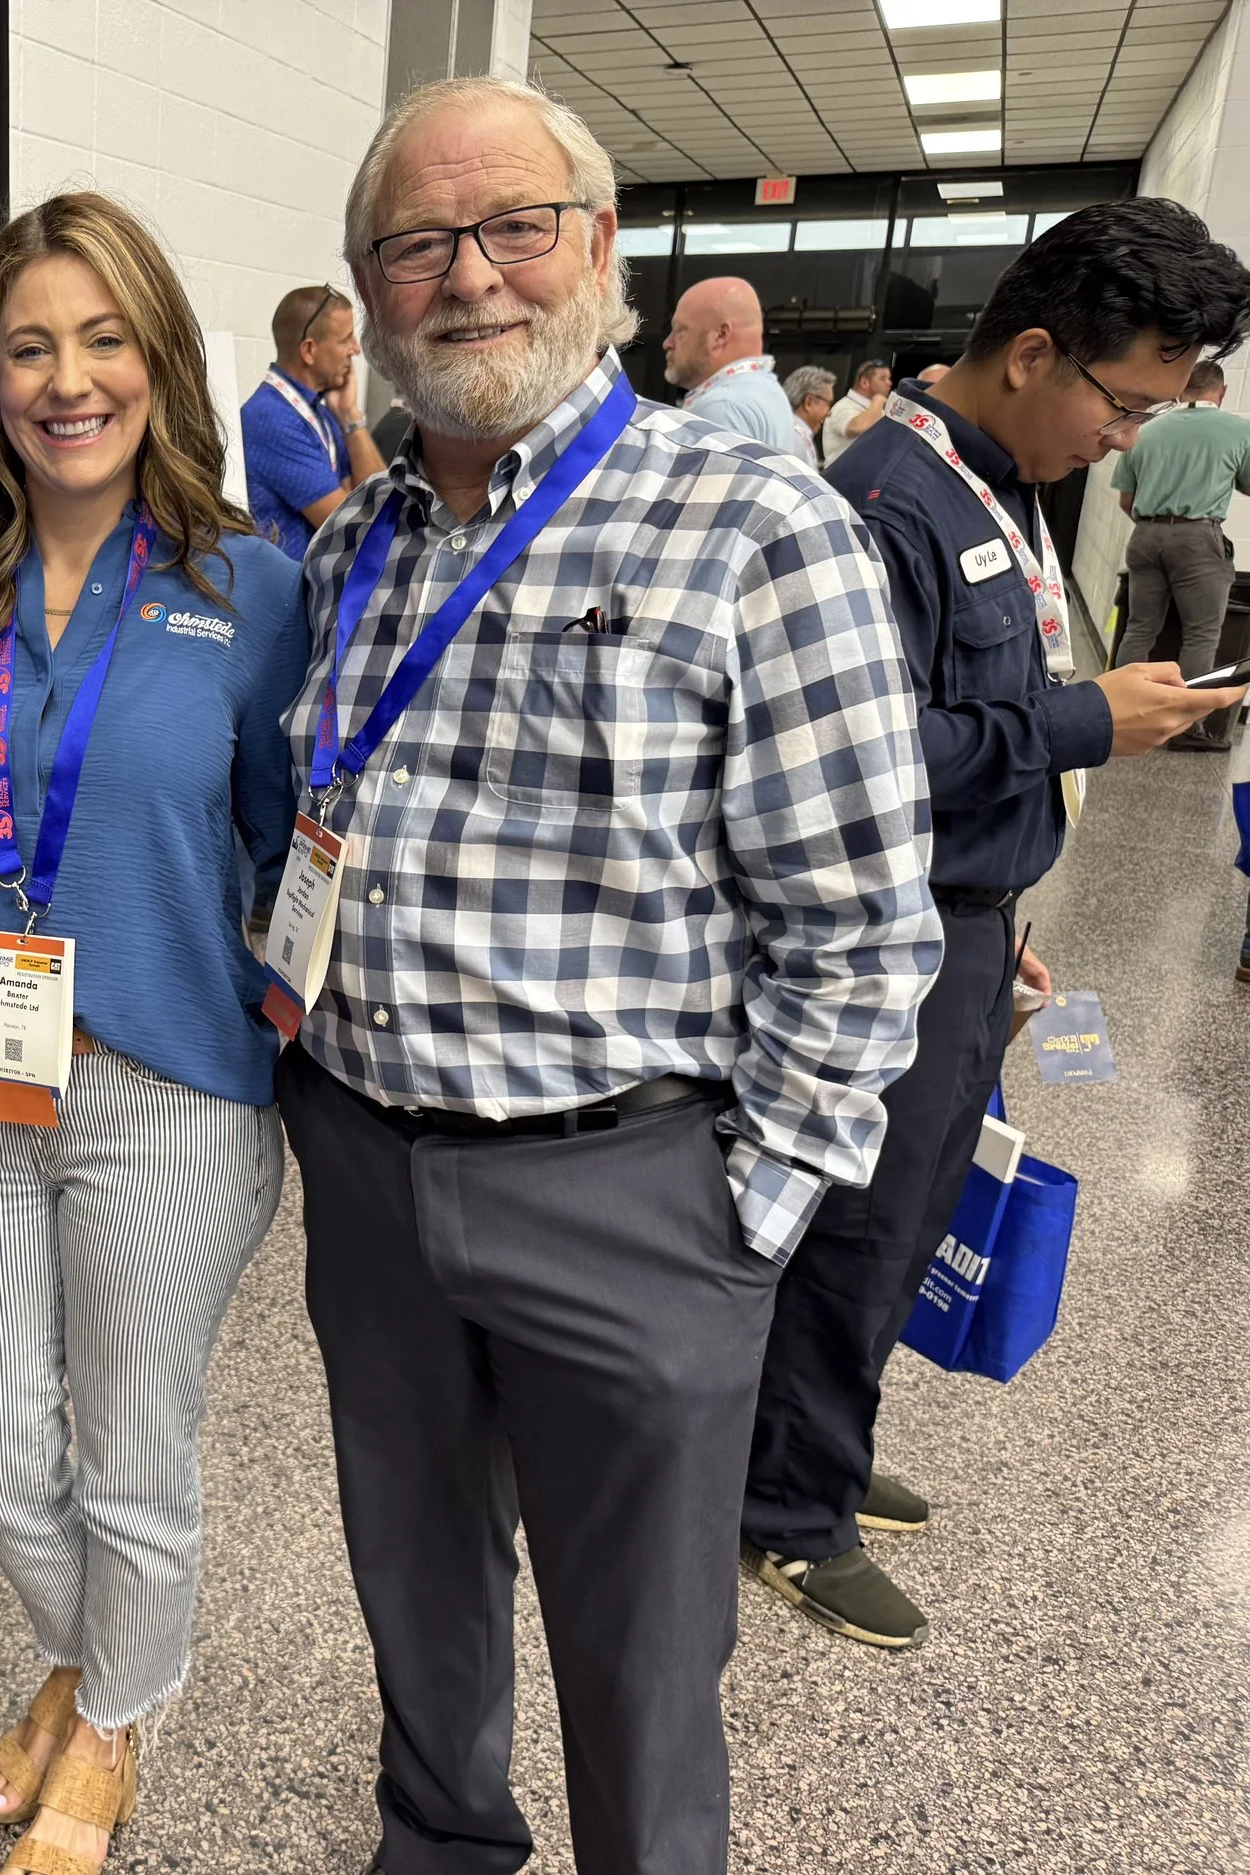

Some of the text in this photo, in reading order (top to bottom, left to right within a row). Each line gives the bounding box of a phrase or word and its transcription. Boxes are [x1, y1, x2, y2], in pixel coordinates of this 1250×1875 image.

[762, 180, 789, 202] EXIT
[975, 551, 997, 567] Uy Le
[166, 624, 196, 637] Industrial
[196, 628, 224, 643] Services
[167, 612, 235, 639] Ohmstede
[298, 870, 316, 890] Joseph
[0, 976, 38, 990] Amanda
[6, 990, 29, 1000] Baxter
[29, 1003, 39, 1012] Ltd
[930, 1266, 955, 1288] greener
[918, 1285, 950, 1313] 9-0198
[922, 1276, 953, 1304] dit.com
